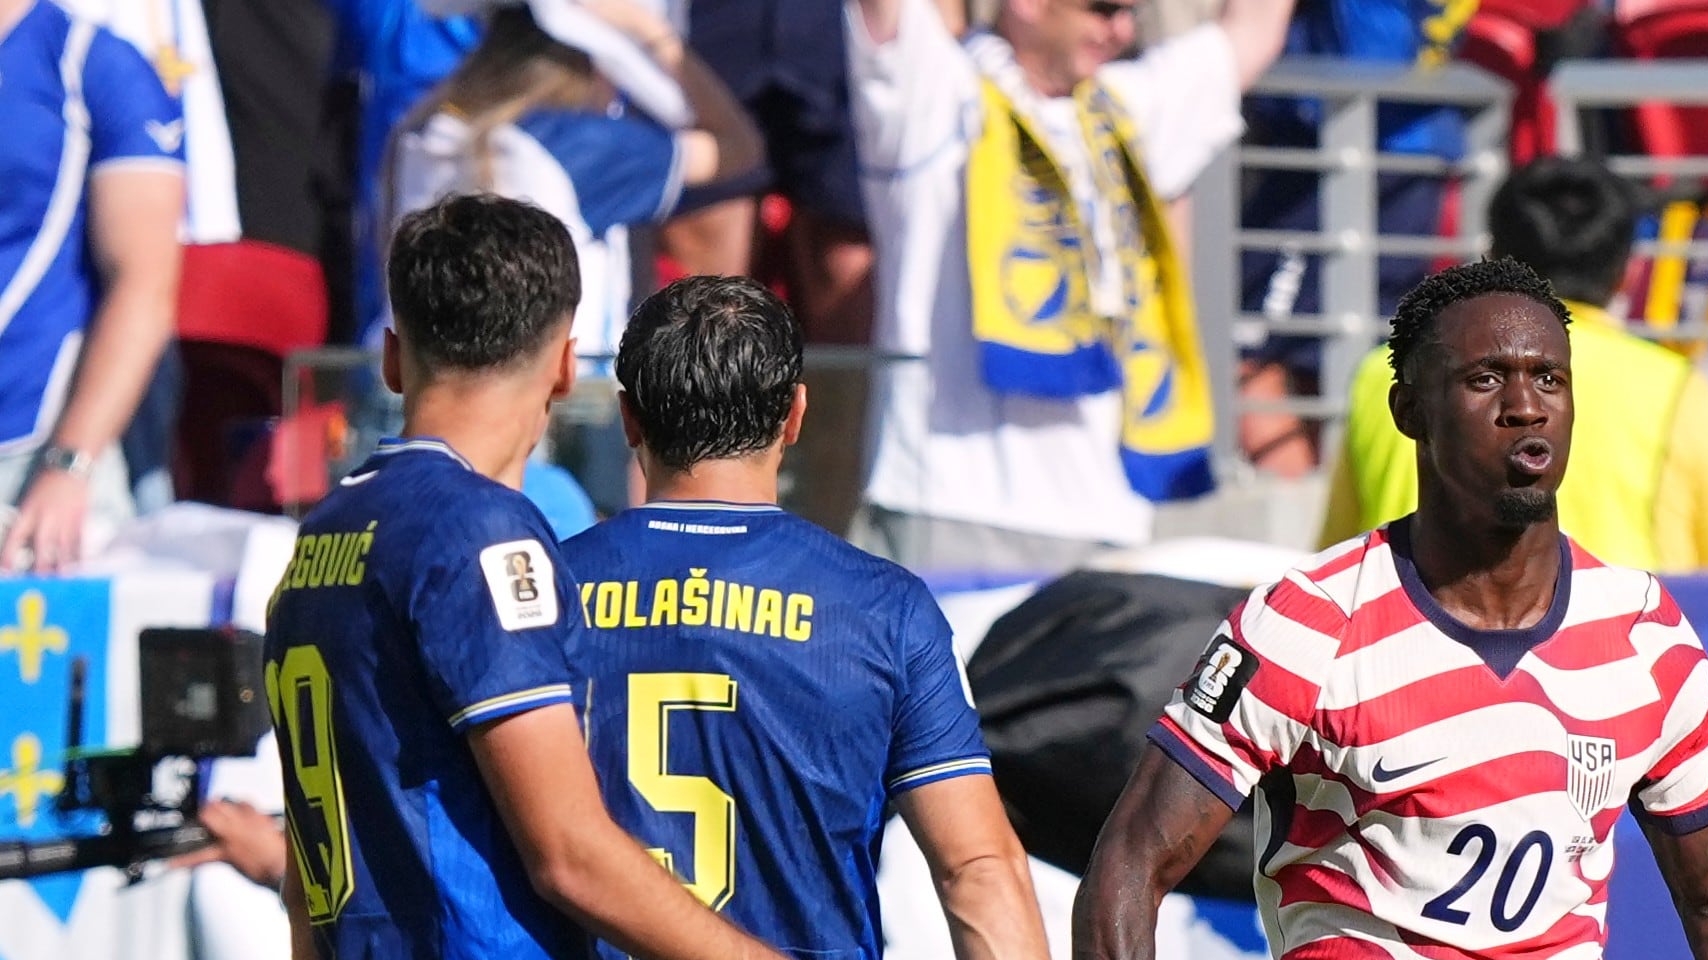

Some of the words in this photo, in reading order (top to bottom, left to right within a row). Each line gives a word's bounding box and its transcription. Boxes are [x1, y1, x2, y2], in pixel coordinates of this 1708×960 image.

[628, 673, 737, 912] 5
[1571, 739, 1612, 772] USA
[1421, 823, 1553, 932] 20
